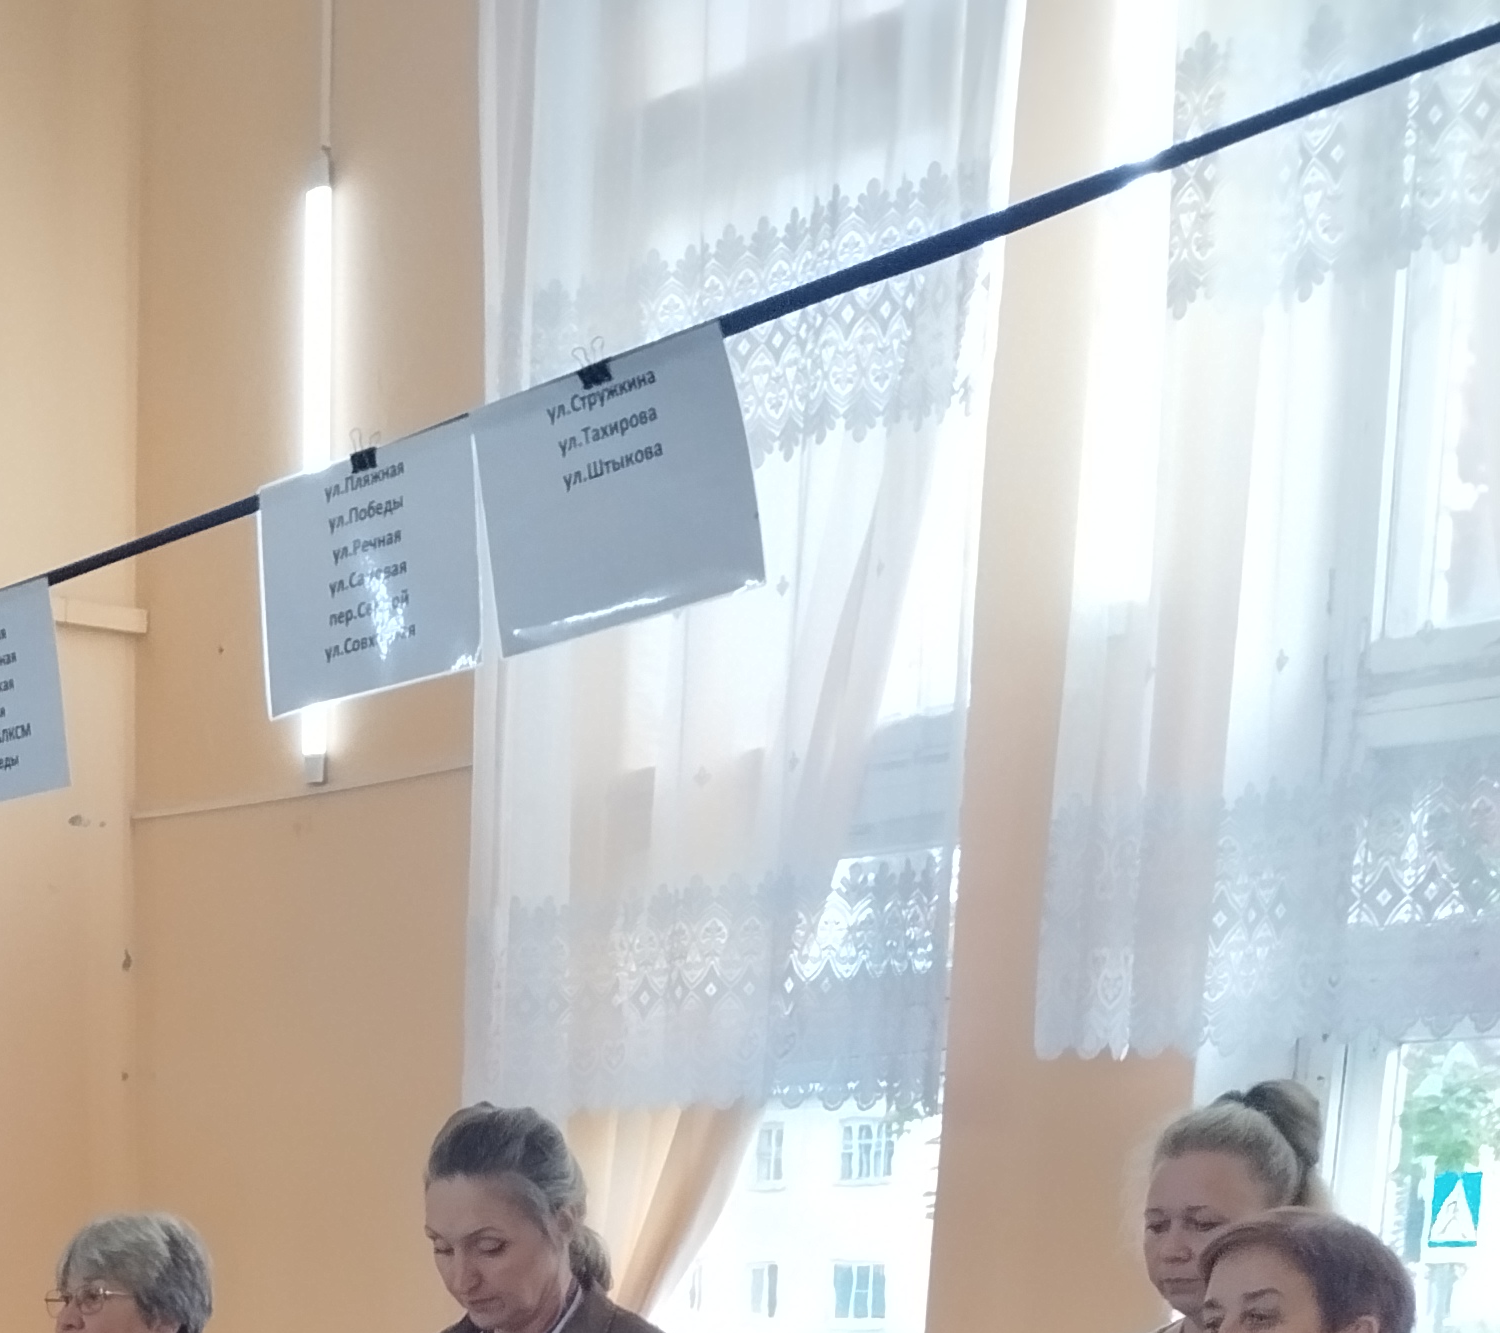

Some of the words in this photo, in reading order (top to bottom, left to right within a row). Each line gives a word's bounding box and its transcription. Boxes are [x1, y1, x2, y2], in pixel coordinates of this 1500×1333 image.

[546, 371, 656, 425] ул.Стружкина
[558, 407, 658, 458] ул.Тахирова
[324, 461, 404, 503] ул.Пляжная
[563, 442, 663, 492] ул.Штыкова
[329, 496, 403, 534] ул.Победы
[333, 529, 402, 566] ул.Речная
